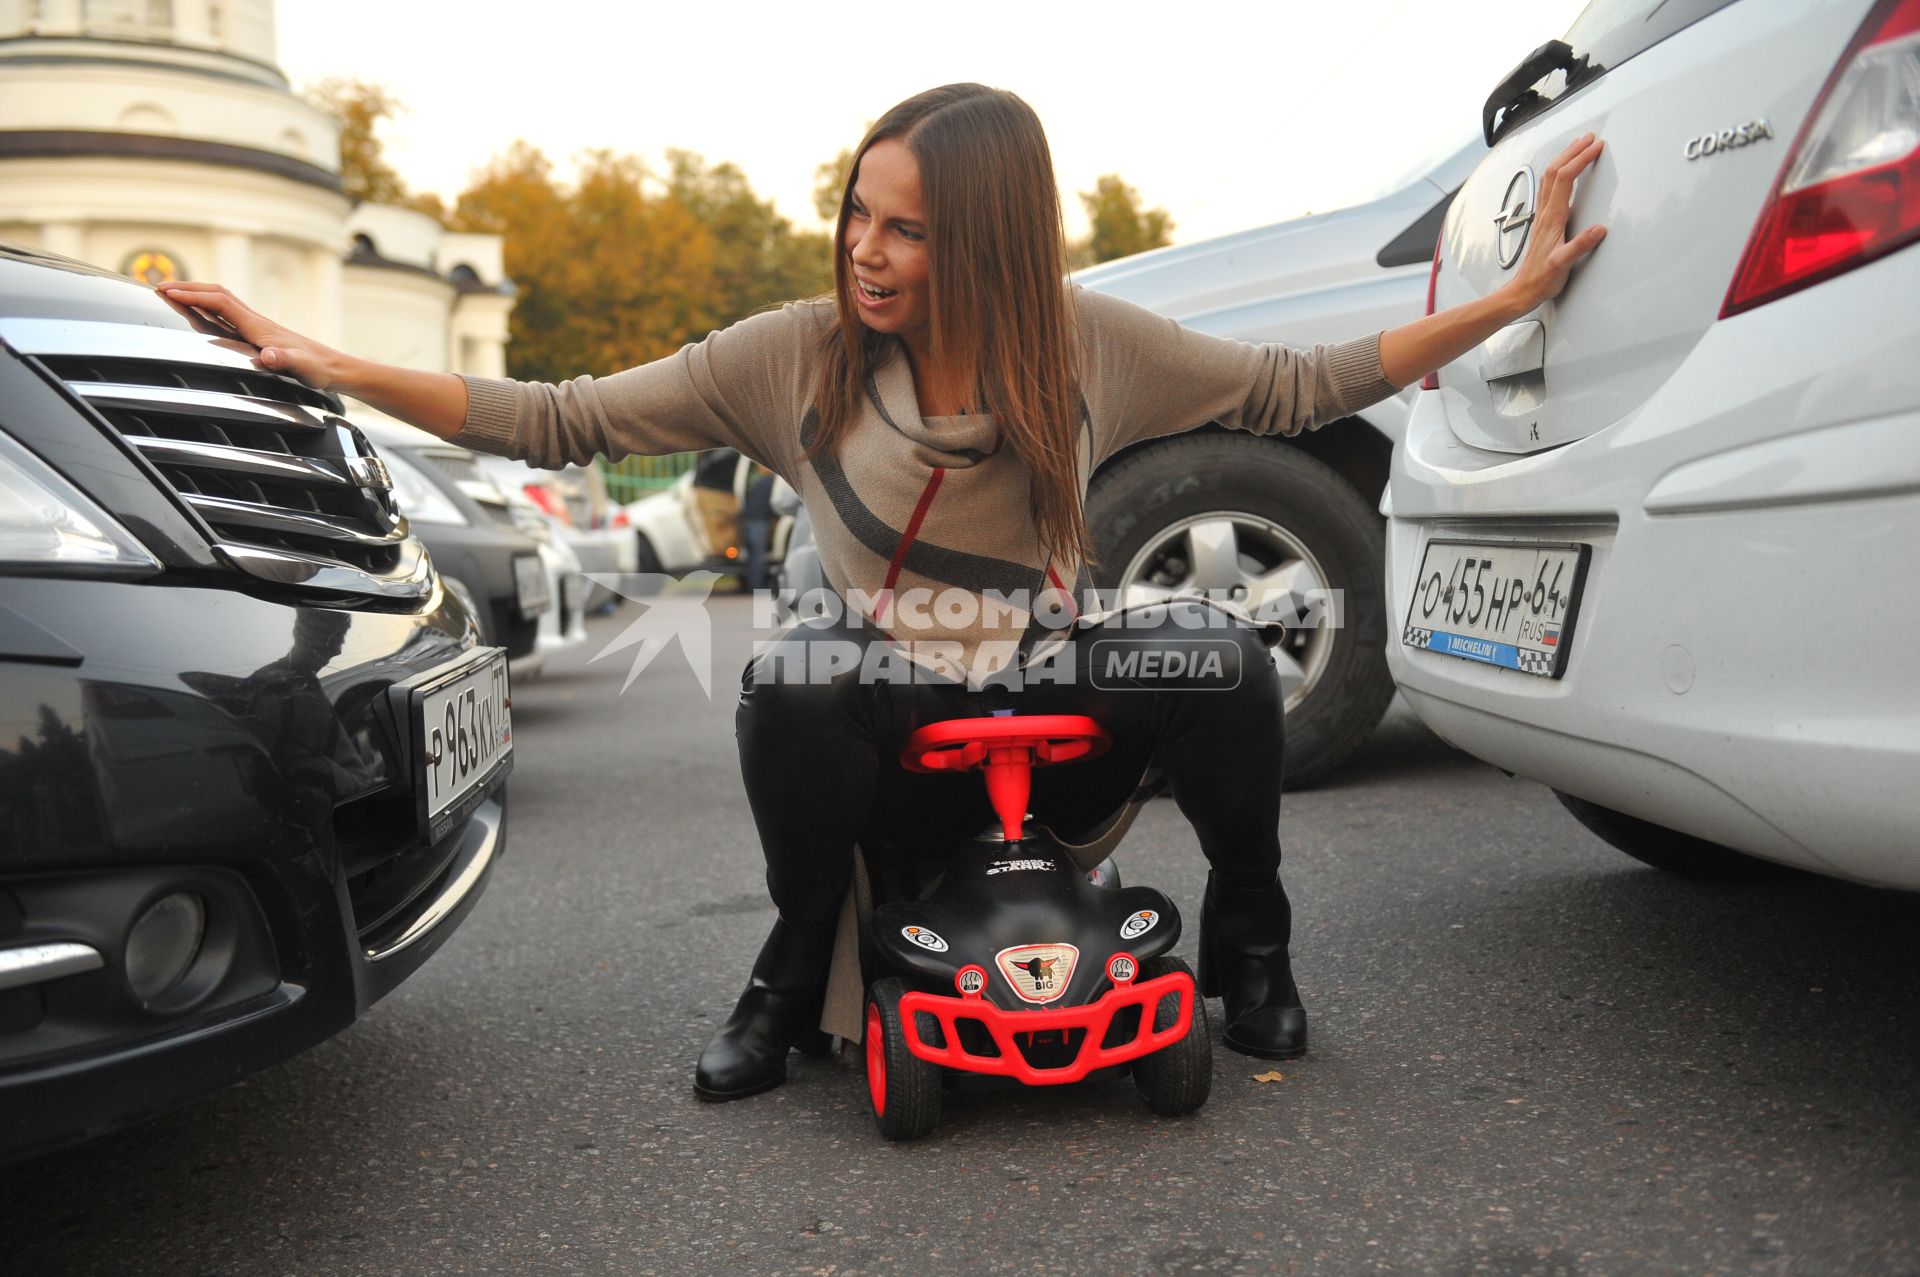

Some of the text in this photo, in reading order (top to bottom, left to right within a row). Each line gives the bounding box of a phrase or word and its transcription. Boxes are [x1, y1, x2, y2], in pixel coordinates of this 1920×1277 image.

[1684, 117, 1774, 161] CORSA
[1531, 558, 1564, 618] 64
[1521, 622, 1544, 642] RUS
[1451, 636, 1493, 657] MICHELIN
[1034, 980, 1054, 991] BIG
